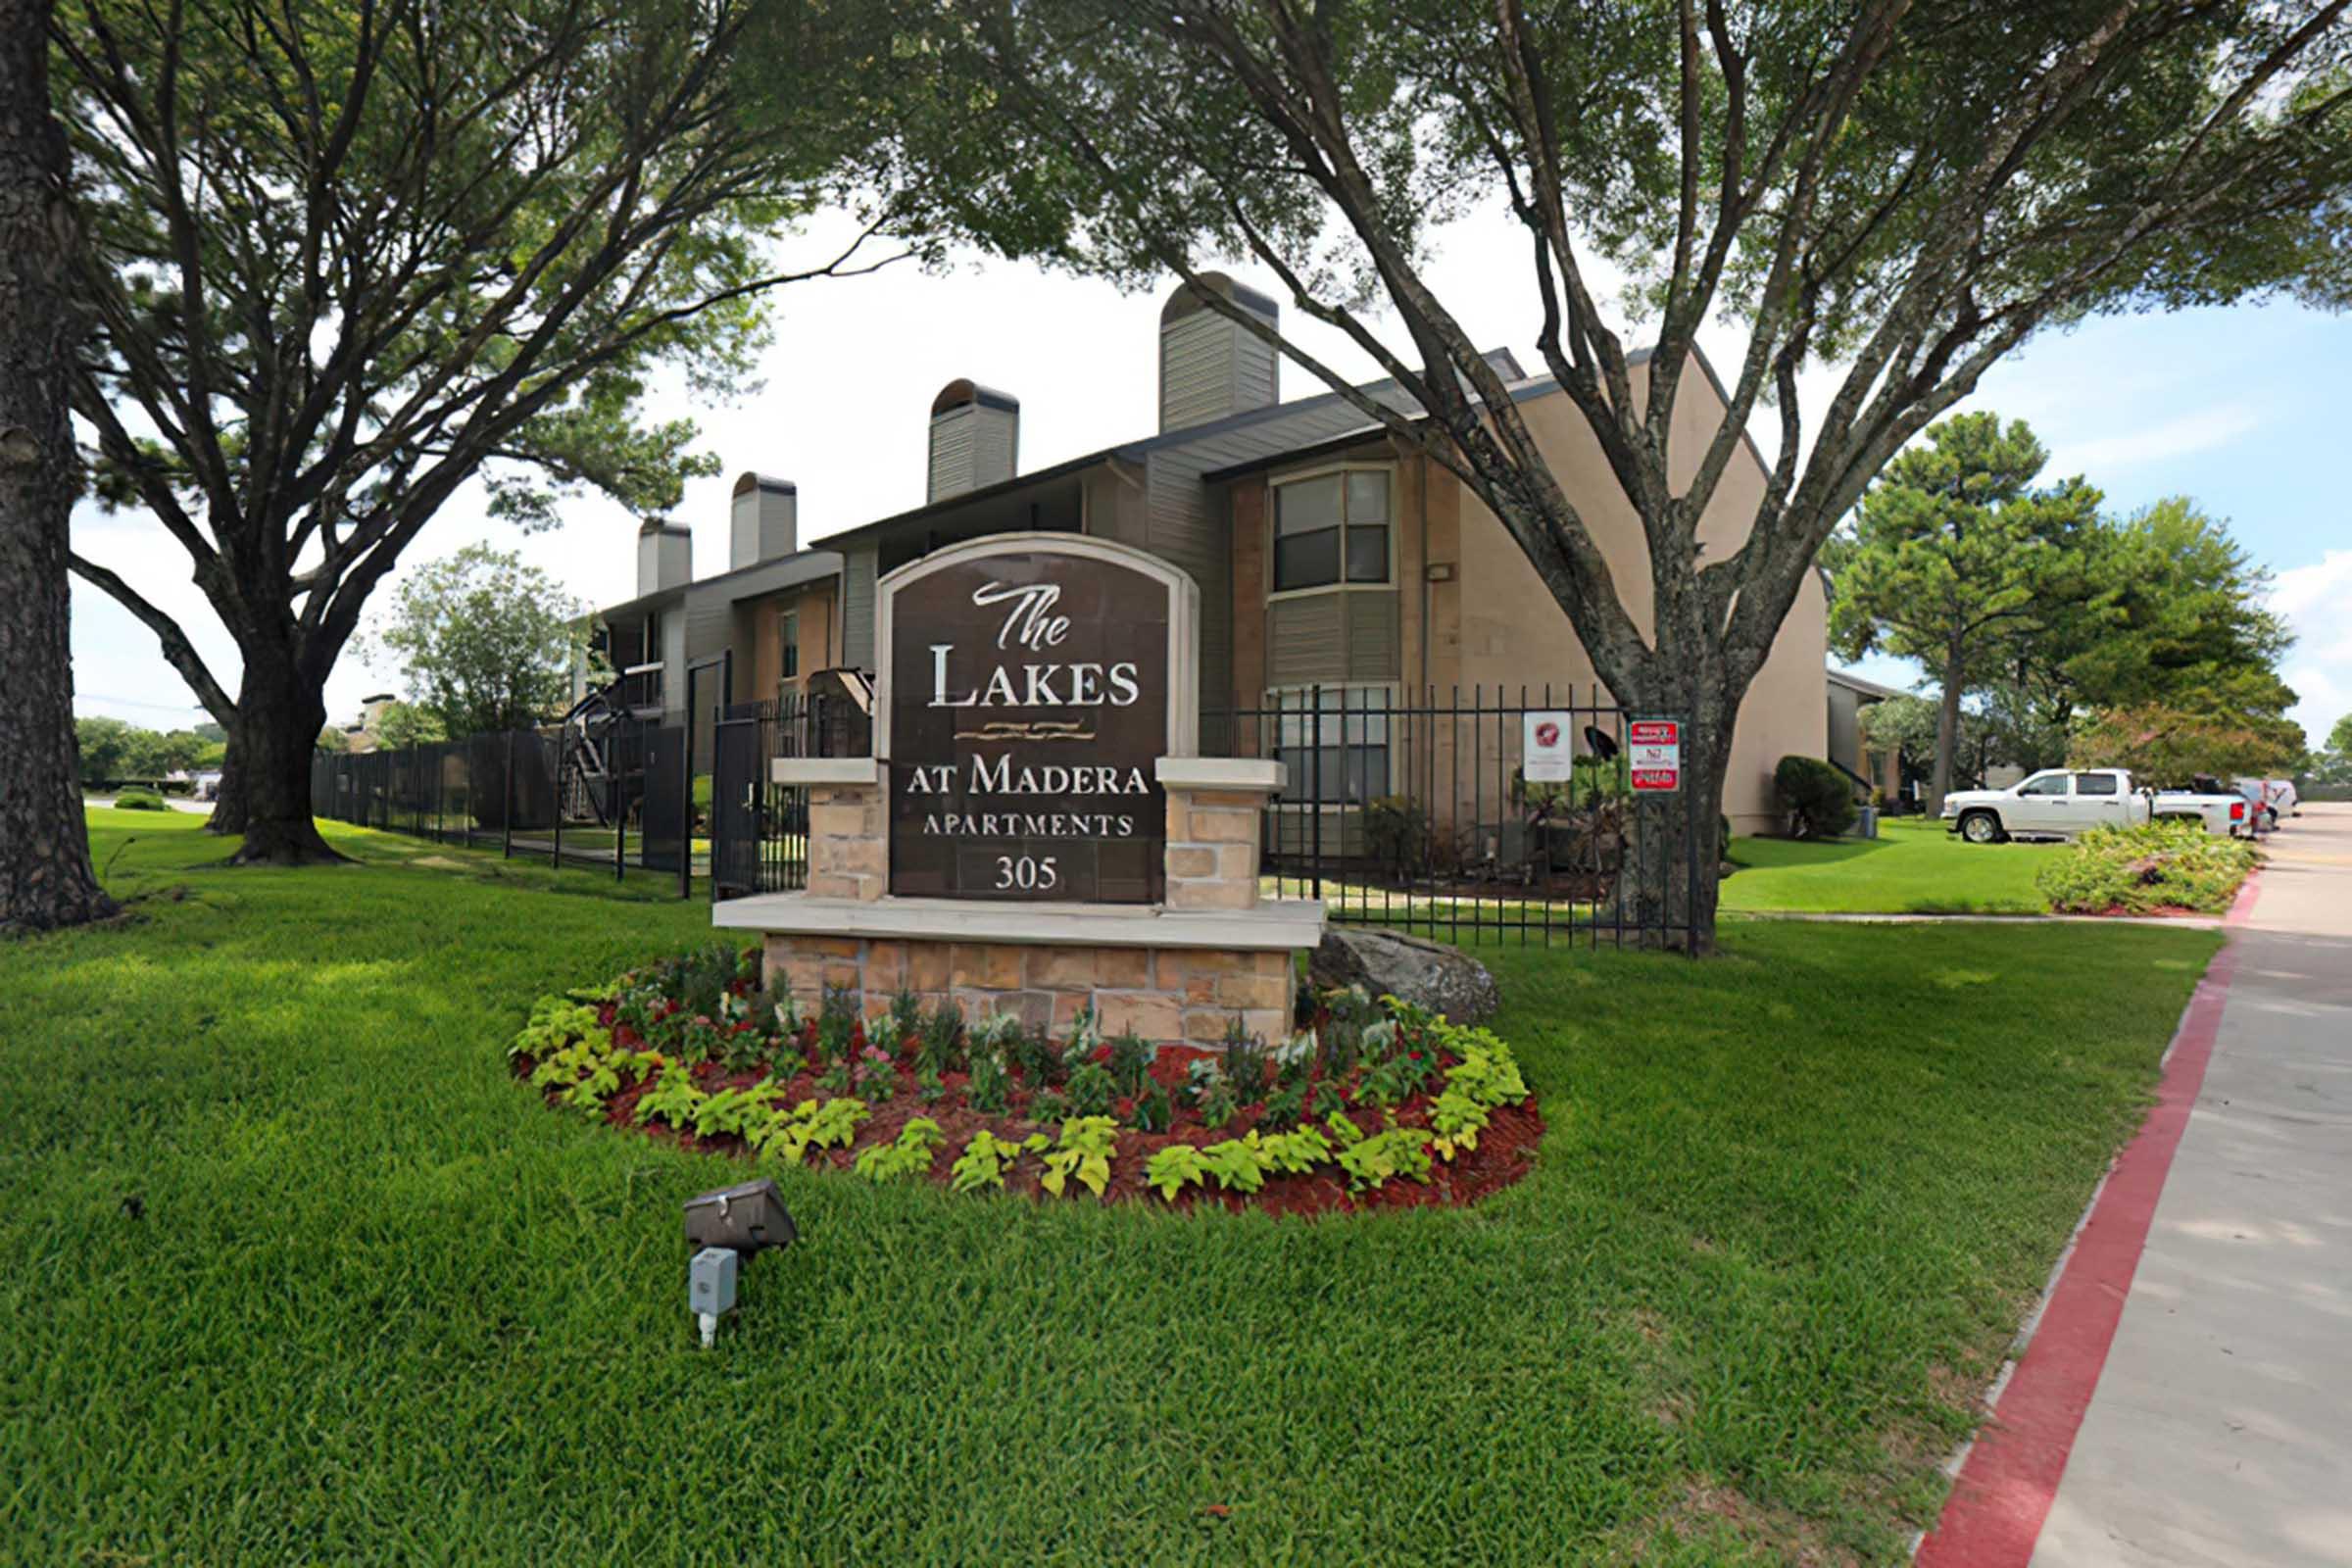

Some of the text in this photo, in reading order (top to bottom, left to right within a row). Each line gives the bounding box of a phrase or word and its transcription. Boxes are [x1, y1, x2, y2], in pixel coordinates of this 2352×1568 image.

[972, 581, 1070, 651] The
[927, 644, 1139, 707] LAKES
[907, 754, 1149, 794] AT MADERA
[923, 813, 1134, 835] APARTMENTS
[995, 856, 1056, 889] 305
